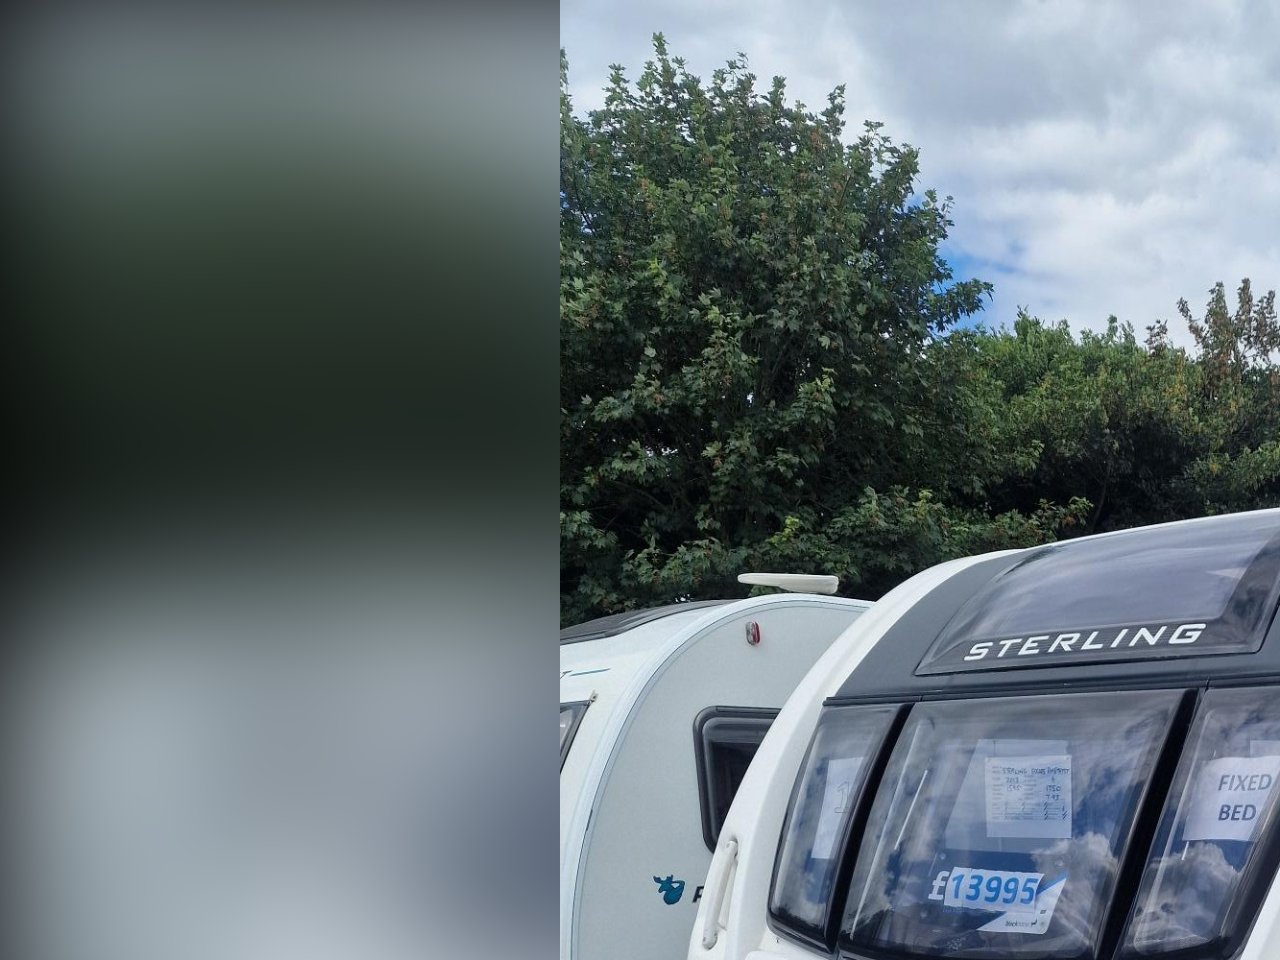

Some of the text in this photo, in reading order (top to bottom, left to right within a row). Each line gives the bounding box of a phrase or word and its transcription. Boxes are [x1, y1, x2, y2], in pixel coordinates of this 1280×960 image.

[964, 623, 1207, 661] STERLING
[1218, 774, 1272, 791] FIXED
[1218, 804, 1257, 821] BED
[928, 870, 1038, 905] £13995
